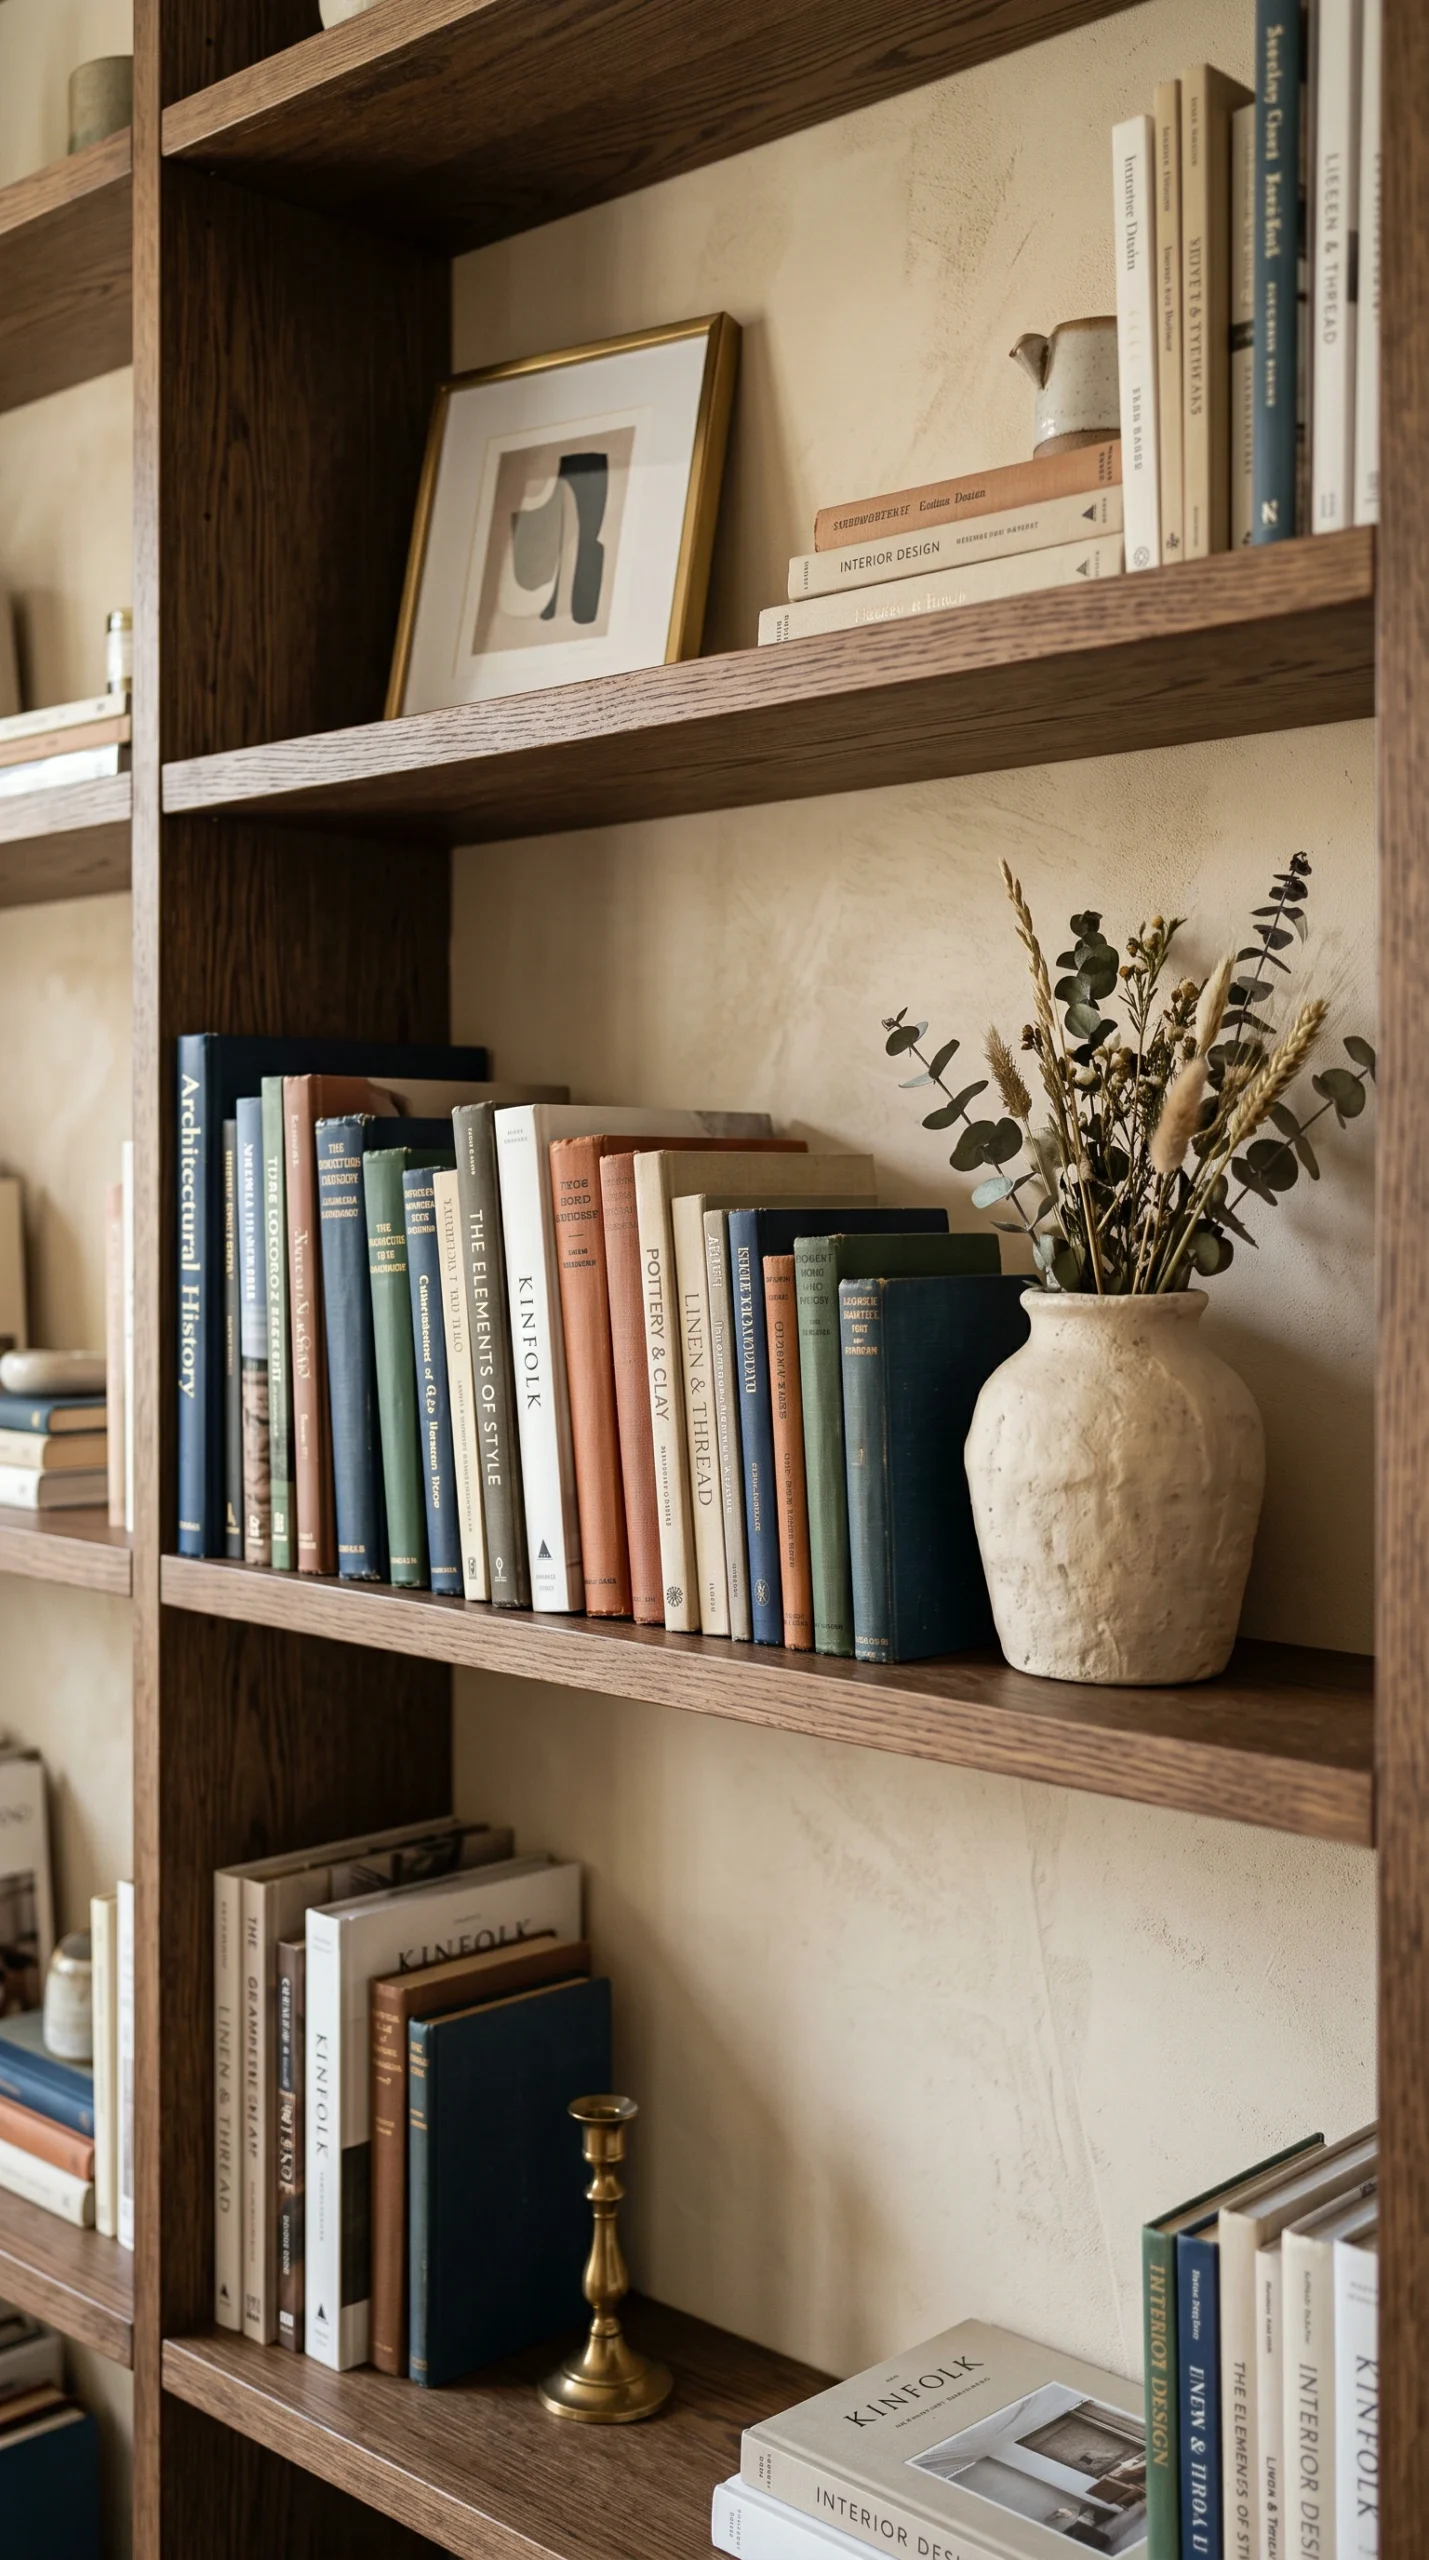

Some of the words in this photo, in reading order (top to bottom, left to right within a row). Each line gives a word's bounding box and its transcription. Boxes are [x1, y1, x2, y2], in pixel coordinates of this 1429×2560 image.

[1326, 241, 1338, 255] &
[1324, 263, 1339, 346] THREAD
[840, 551, 893, 573] INTERIOR
[897, 541, 940, 561] DESIGN
[180, 1073, 200, 1278] Architectural
[468, 1209, 484, 1248] THE
[471, 1255, 493, 1380] ELEMENTS
[645, 1247, 667, 1344] POTTERY
[684, 1293, 707, 1370] LINEN
[178, 1283, 200, 1400] History
[518, 1275, 543, 1410] KINFOLK
[651, 1346, 665, 1365] &
[482, 1385, 496, 1412] OF
[653, 1368, 670, 1422] CLAY
[690, 1376, 707, 1395] &
[484, 1415, 501, 1486] STYLE
[691, 1401, 714, 1507] THREAD
[246, 1916, 258, 1949] THE
[397, 1918, 531, 1971] KINFOLK
[218, 2005, 231, 2079] LINEN
[219, 2086, 230, 2105] &
[315, 2033, 329, 2158] KINFOLK
[218, 2117, 232, 2214] THREAD
[843, 2355, 985, 2428] KINFOLK
[1234, 2361, 1247, 2399] THE
[1151, 2376, 1169, 2468] DESIGN
[1191, 2436, 1206, 2456] &
[1299, 2363, 1320, 2492] INTERIOR
[1355, 2353, 1379, 2520] KINFOLK
[816, 2486, 908, 2547] INTERIOR
[1237, 2505, 1250, 2528] OF
